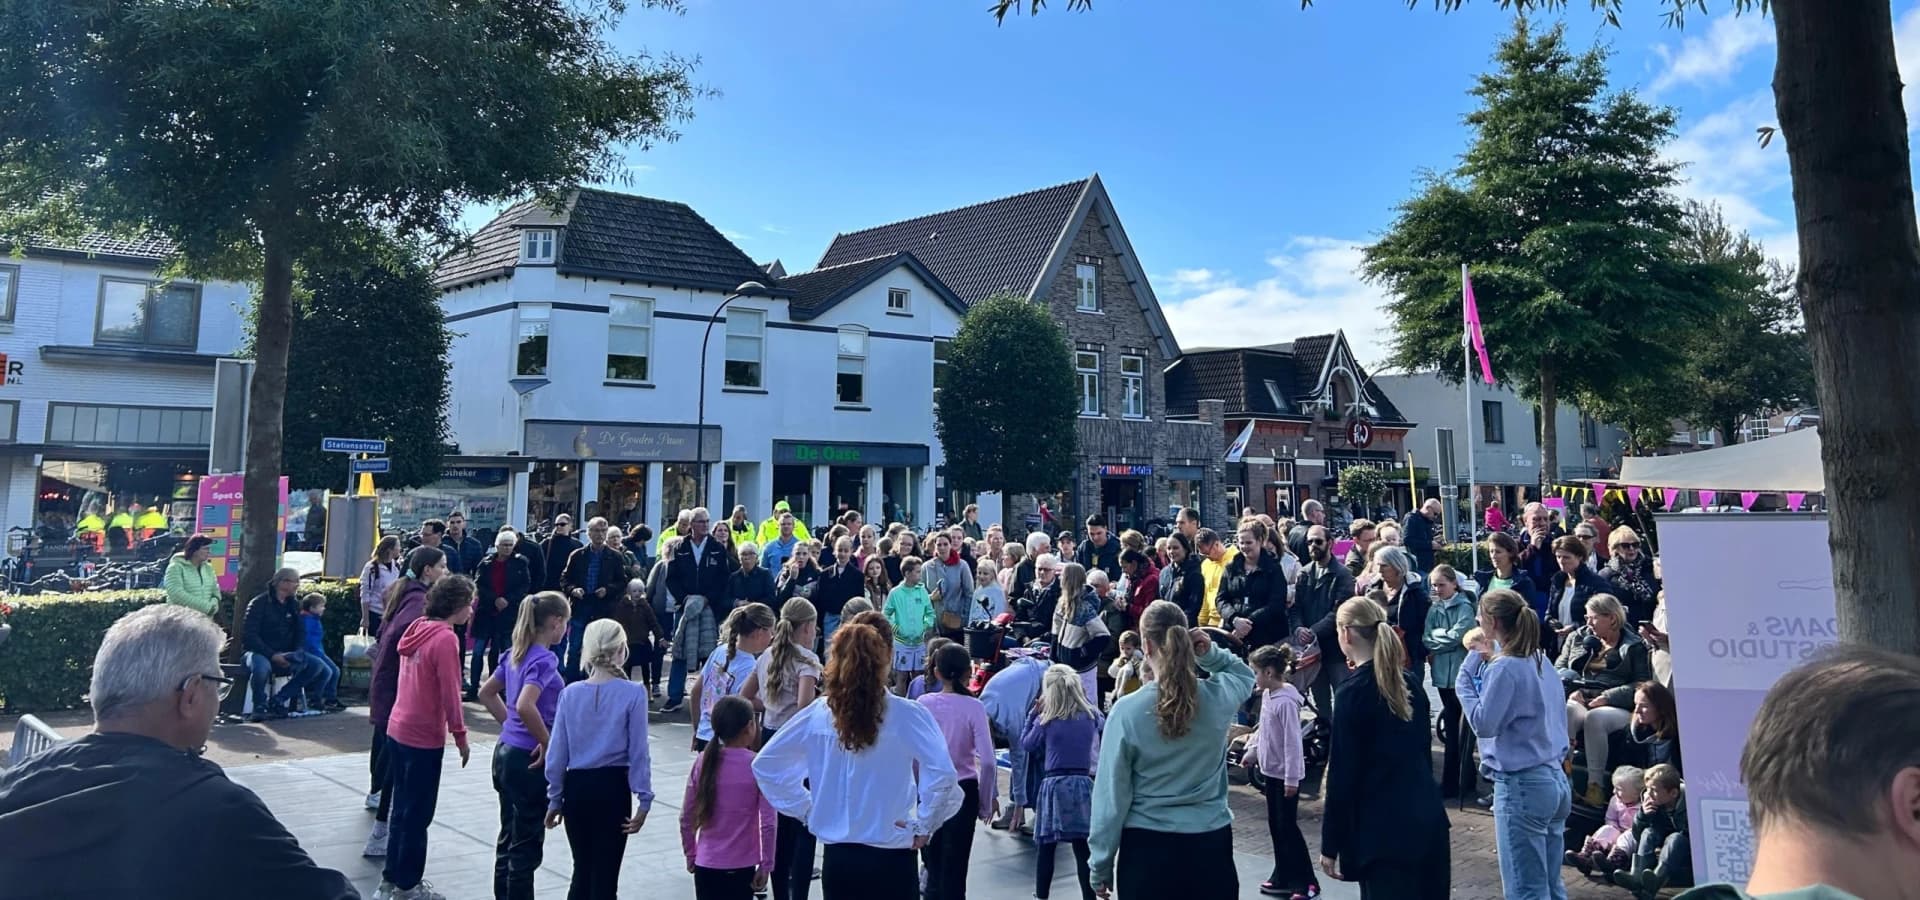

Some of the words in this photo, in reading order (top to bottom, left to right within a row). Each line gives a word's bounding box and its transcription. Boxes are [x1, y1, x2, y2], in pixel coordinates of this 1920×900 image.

[598, 432, 615, 446] De
[327, 441, 382, 450] Stationsstraat
[796, 445, 818, 461] De
[823, 446, 861, 461] Oase
[440, 469, 477, 477] otheker
[212, 492, 233, 500] Spot
